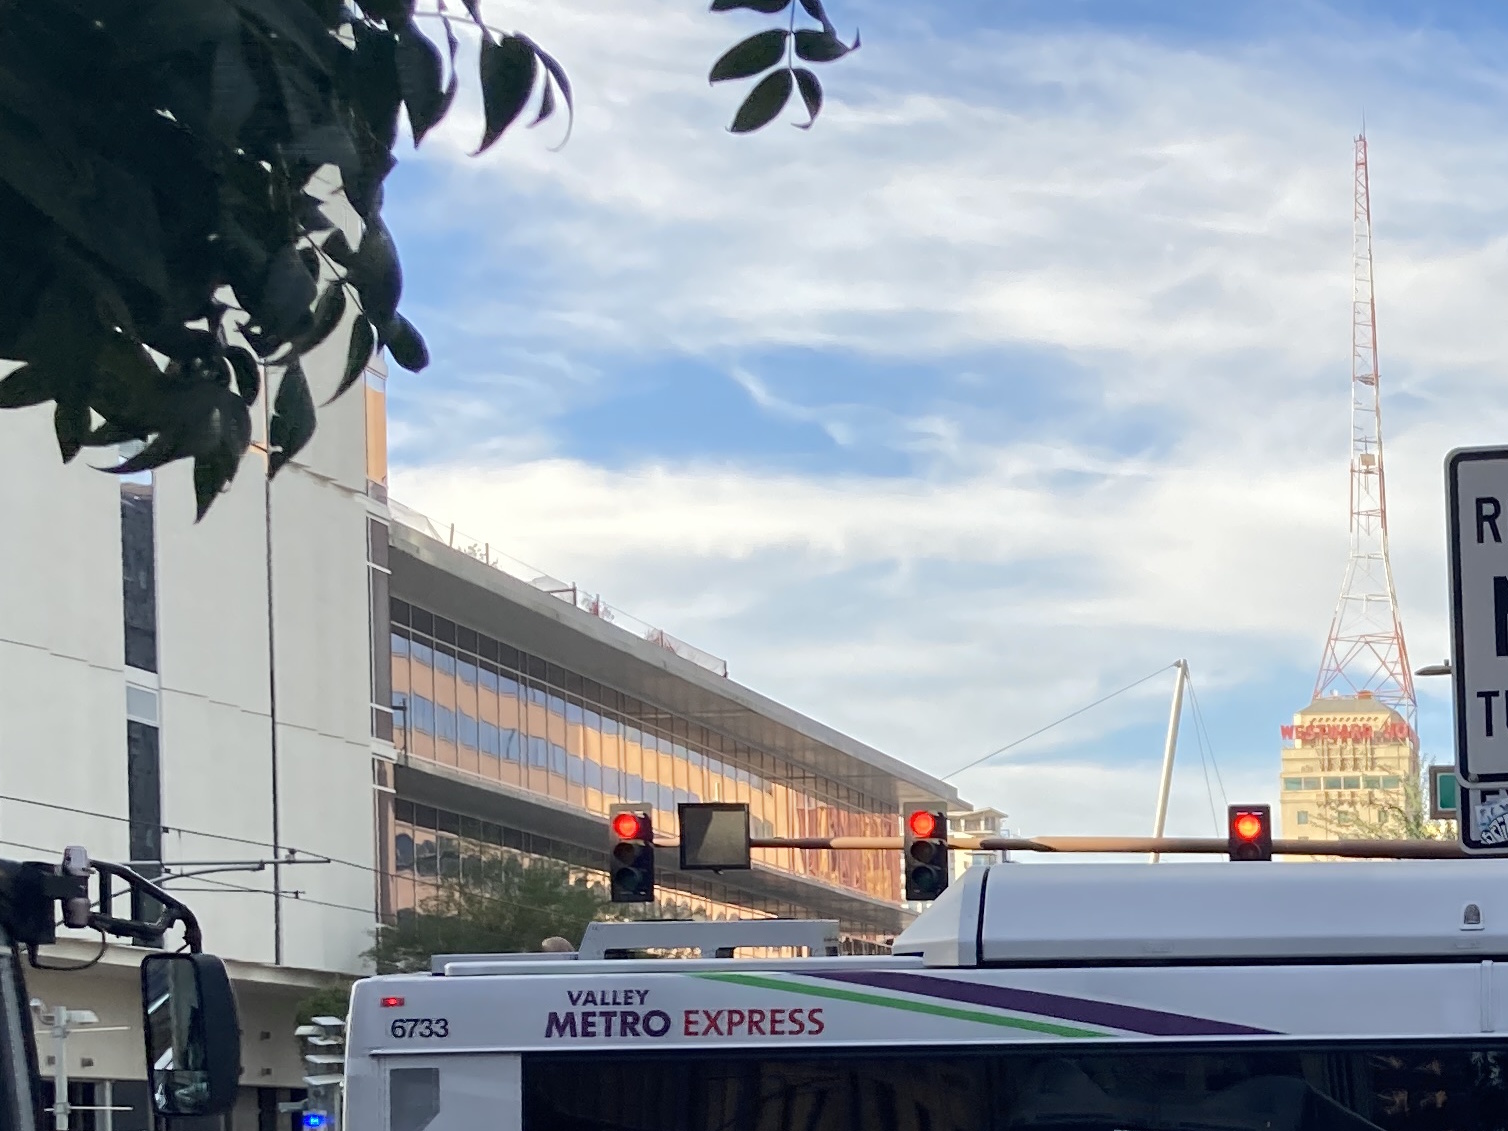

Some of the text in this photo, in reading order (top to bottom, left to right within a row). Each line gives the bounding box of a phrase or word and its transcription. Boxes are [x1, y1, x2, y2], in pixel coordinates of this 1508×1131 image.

[567, 989, 650, 1007] VALLEY
[391, 1017, 449, 1039] 6733
[544, 1008, 825, 1039] METRO EXPRESS
